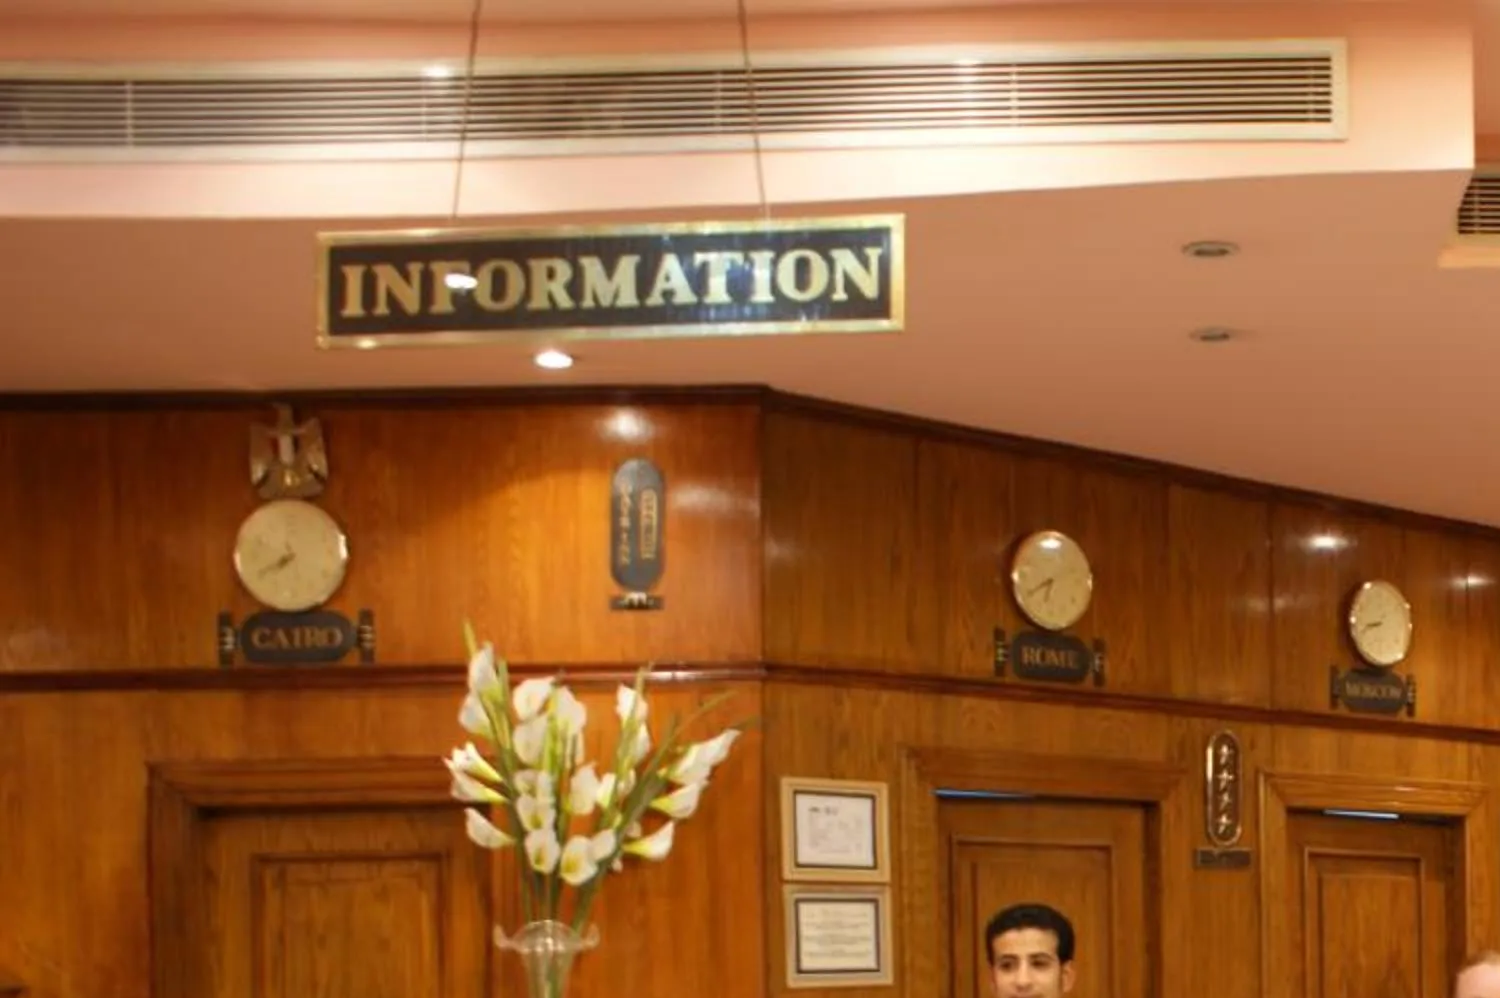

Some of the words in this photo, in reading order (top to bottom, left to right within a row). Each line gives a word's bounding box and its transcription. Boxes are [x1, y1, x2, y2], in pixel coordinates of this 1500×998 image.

[340, 247, 883, 317] INFORMATION
[252, 625, 343, 650] CAIRO
[1021, 644, 1079, 671] ROME
